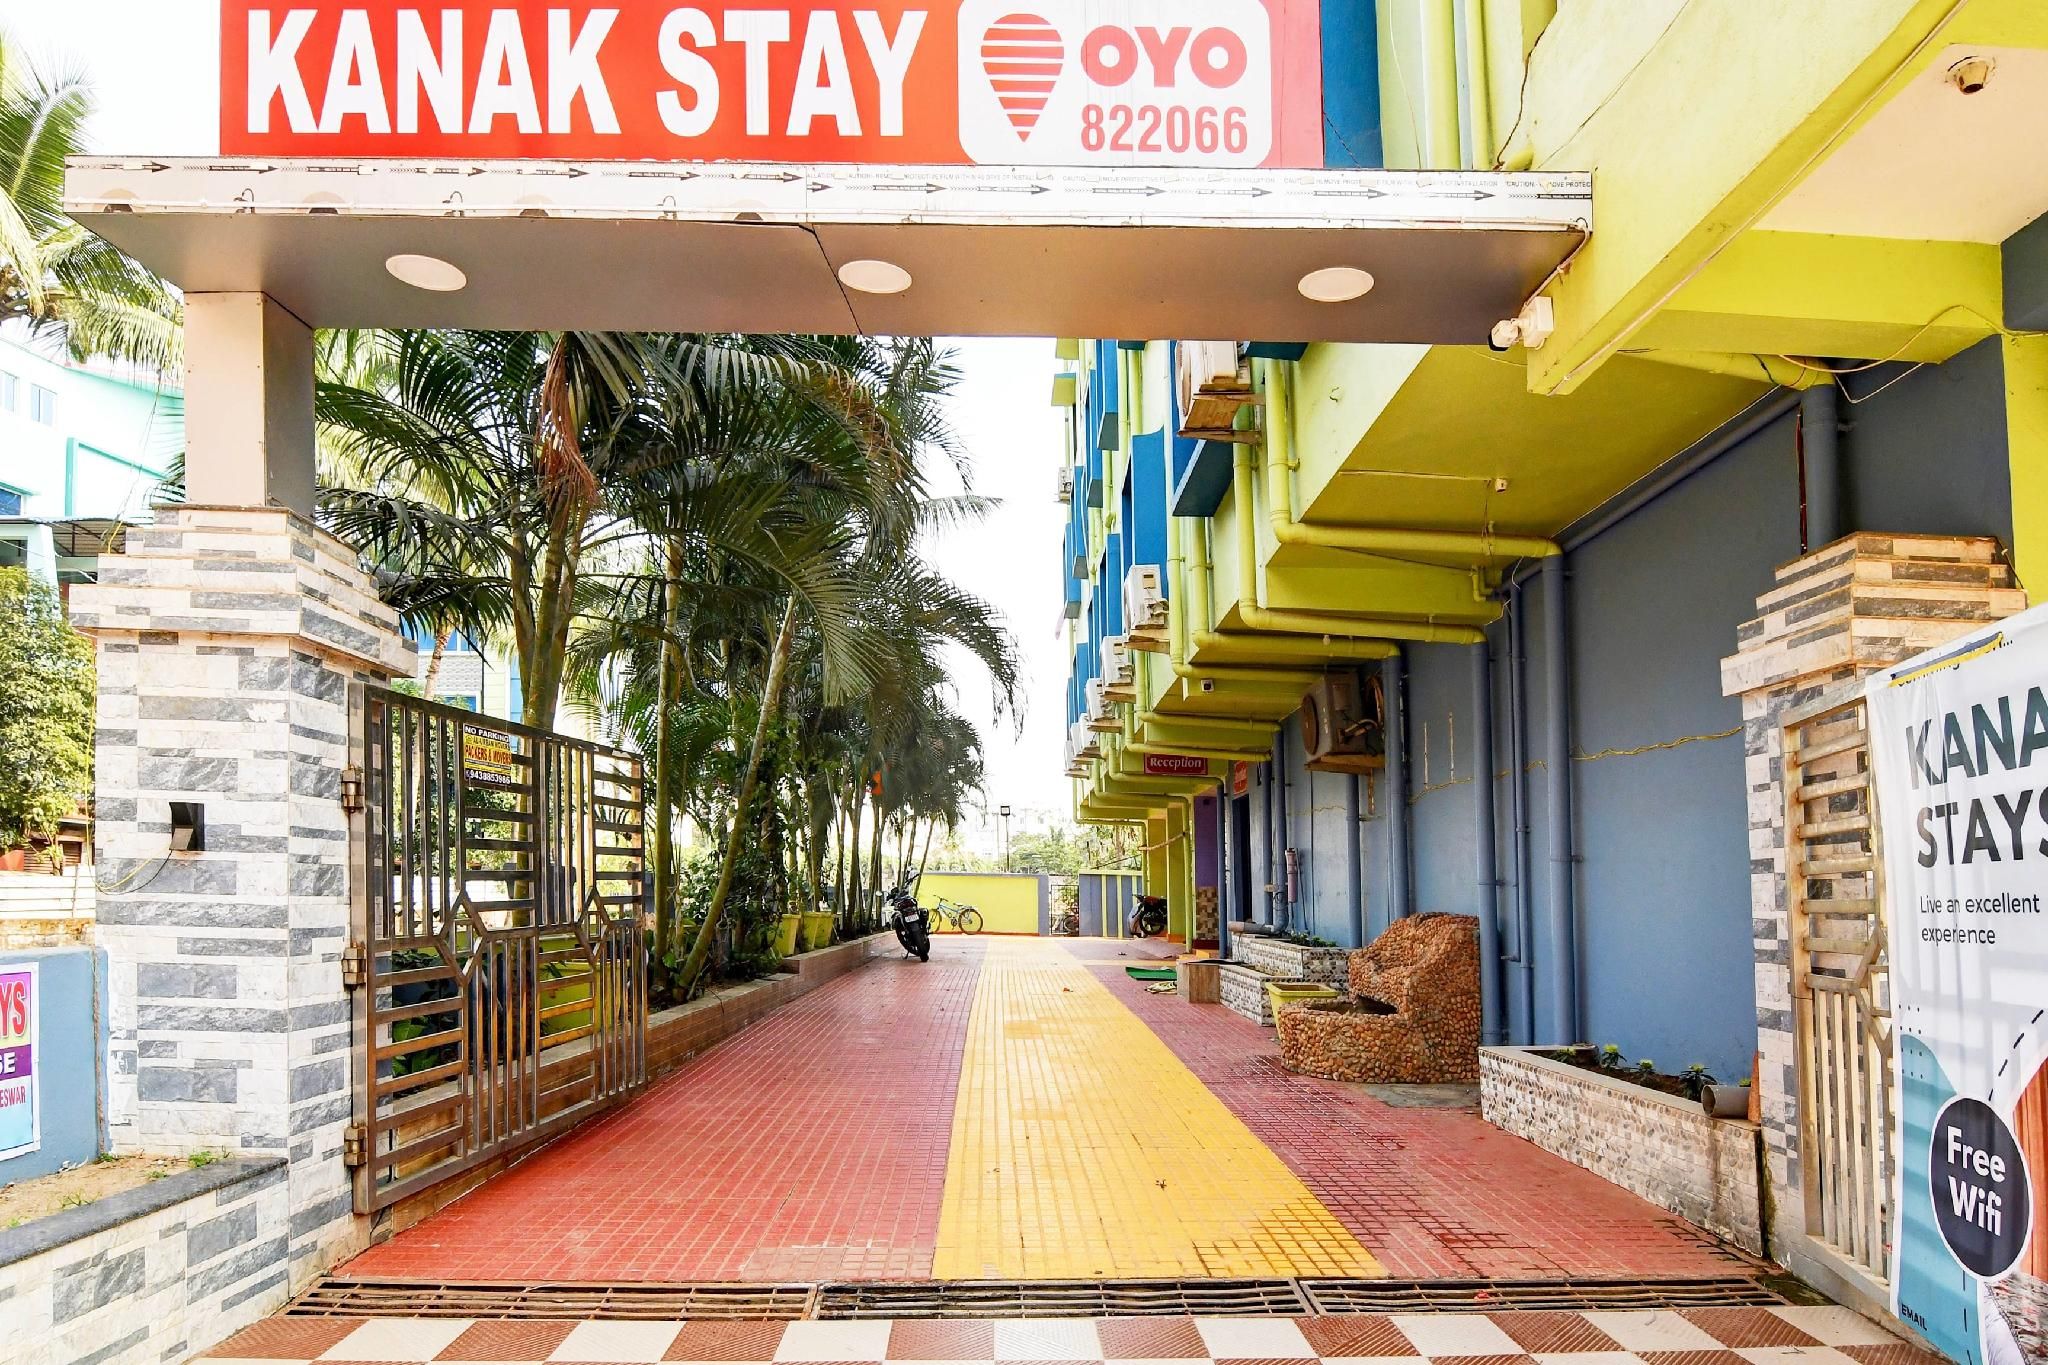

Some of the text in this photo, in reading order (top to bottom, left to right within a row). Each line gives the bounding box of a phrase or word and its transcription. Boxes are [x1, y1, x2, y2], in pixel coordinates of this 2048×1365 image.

[1080, 25, 1248, 88] OYO
[248, 7, 927, 137] KANAK STAY
[1080, 104, 1248, 153] 822066
[465, 726, 509, 743] NO PARKING
[465, 744, 487, 761] PACKERS
[493, 749, 512, 765] MOVERS
[1150, 757, 1201, 770] Reception
[1920, 892, 2040, 914] Live an excellent
[1921, 922, 1996, 946] experience
[1947, 1125, 2006, 1183] Free
[1948, 1174, 2002, 1237] Wifi
[1901, 1303, 1928, 1332] EMAIL
